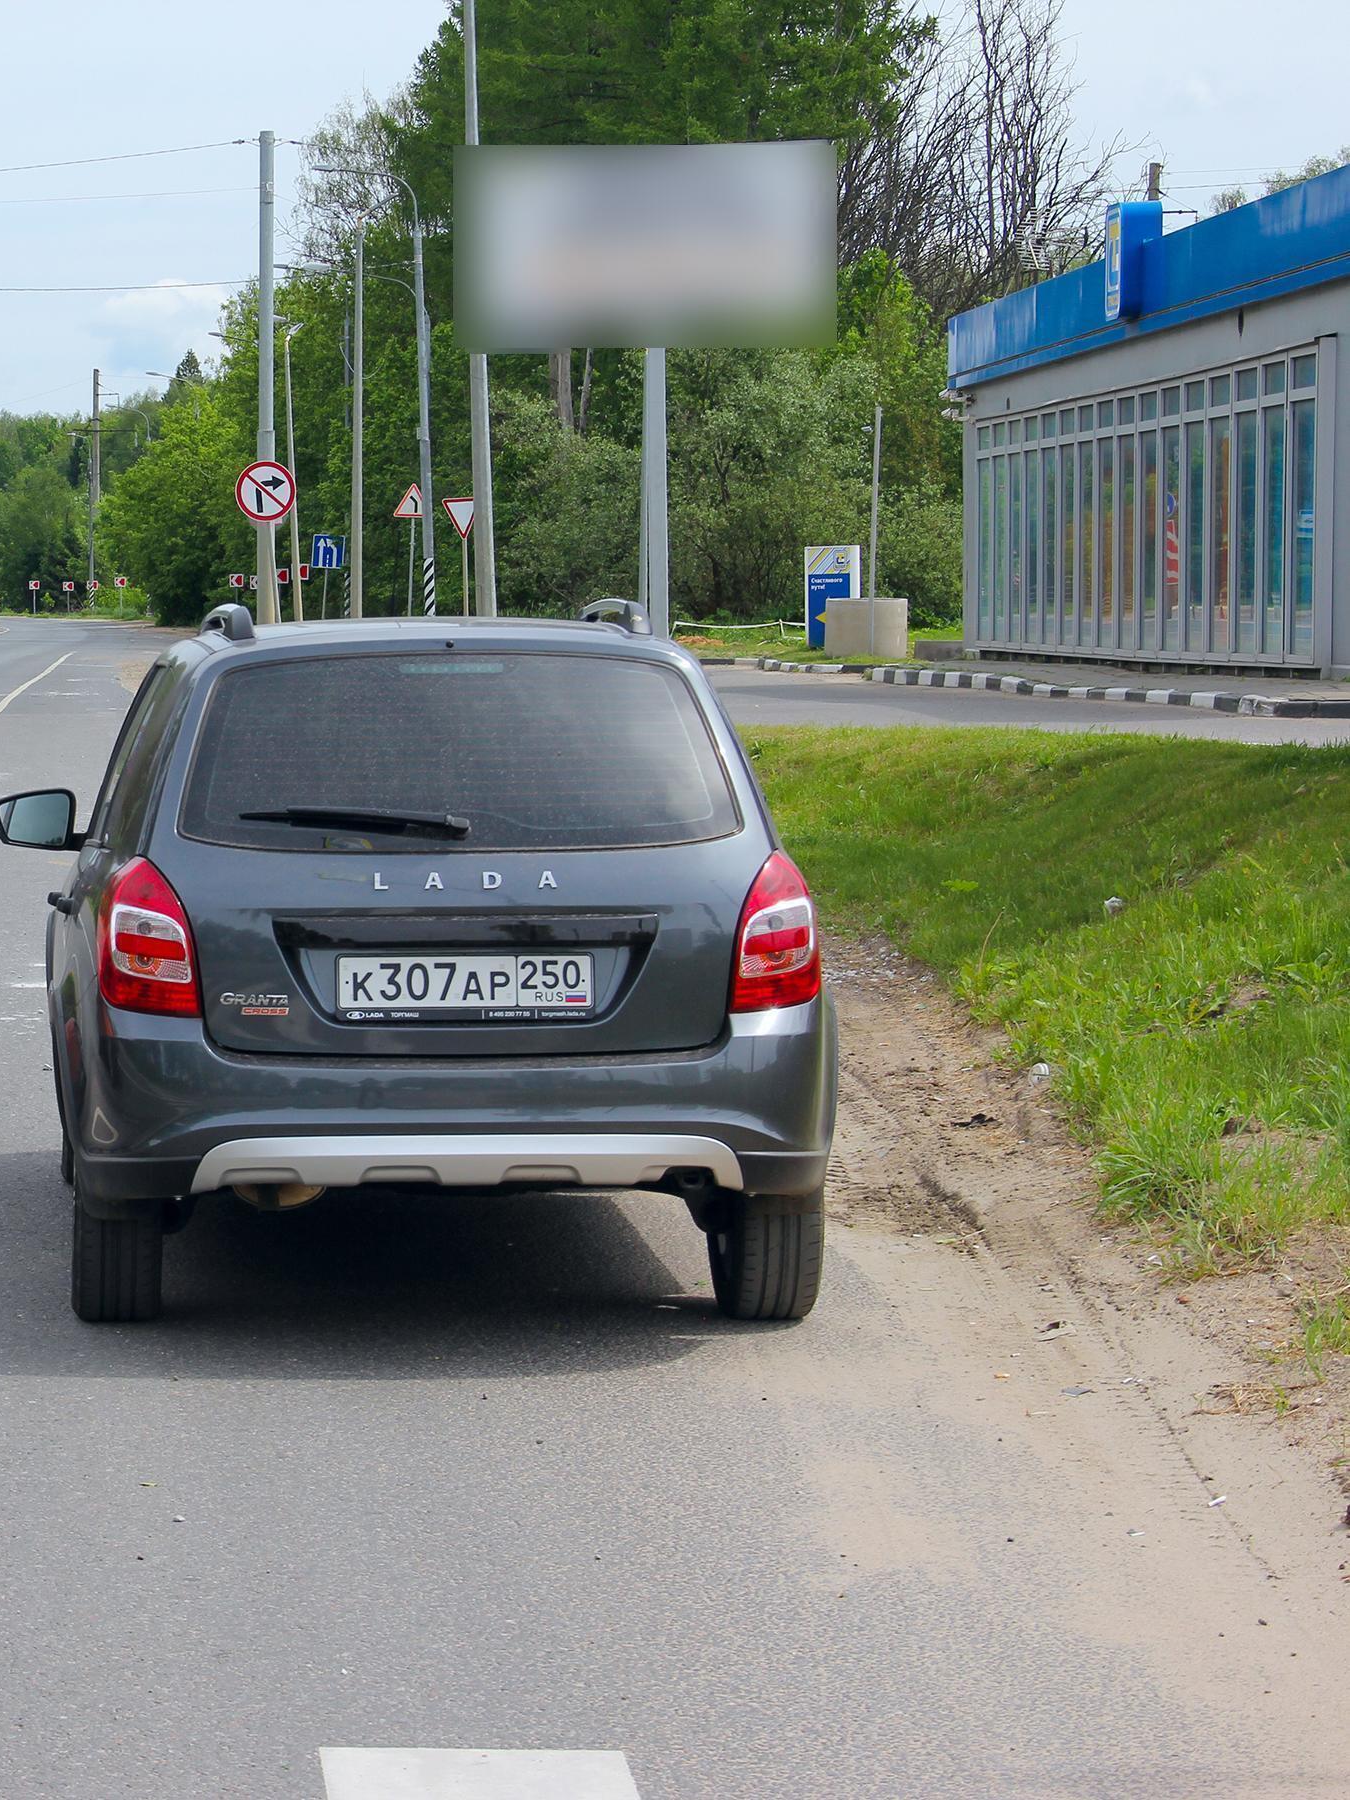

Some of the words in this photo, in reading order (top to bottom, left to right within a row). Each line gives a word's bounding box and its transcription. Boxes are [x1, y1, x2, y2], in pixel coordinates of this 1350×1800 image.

[373, 870, 558, 890] LADA
[520, 960, 581, 990] 250
[535, 991, 564, 1002] RUS
[242, 1007, 288, 1015] CROSS
